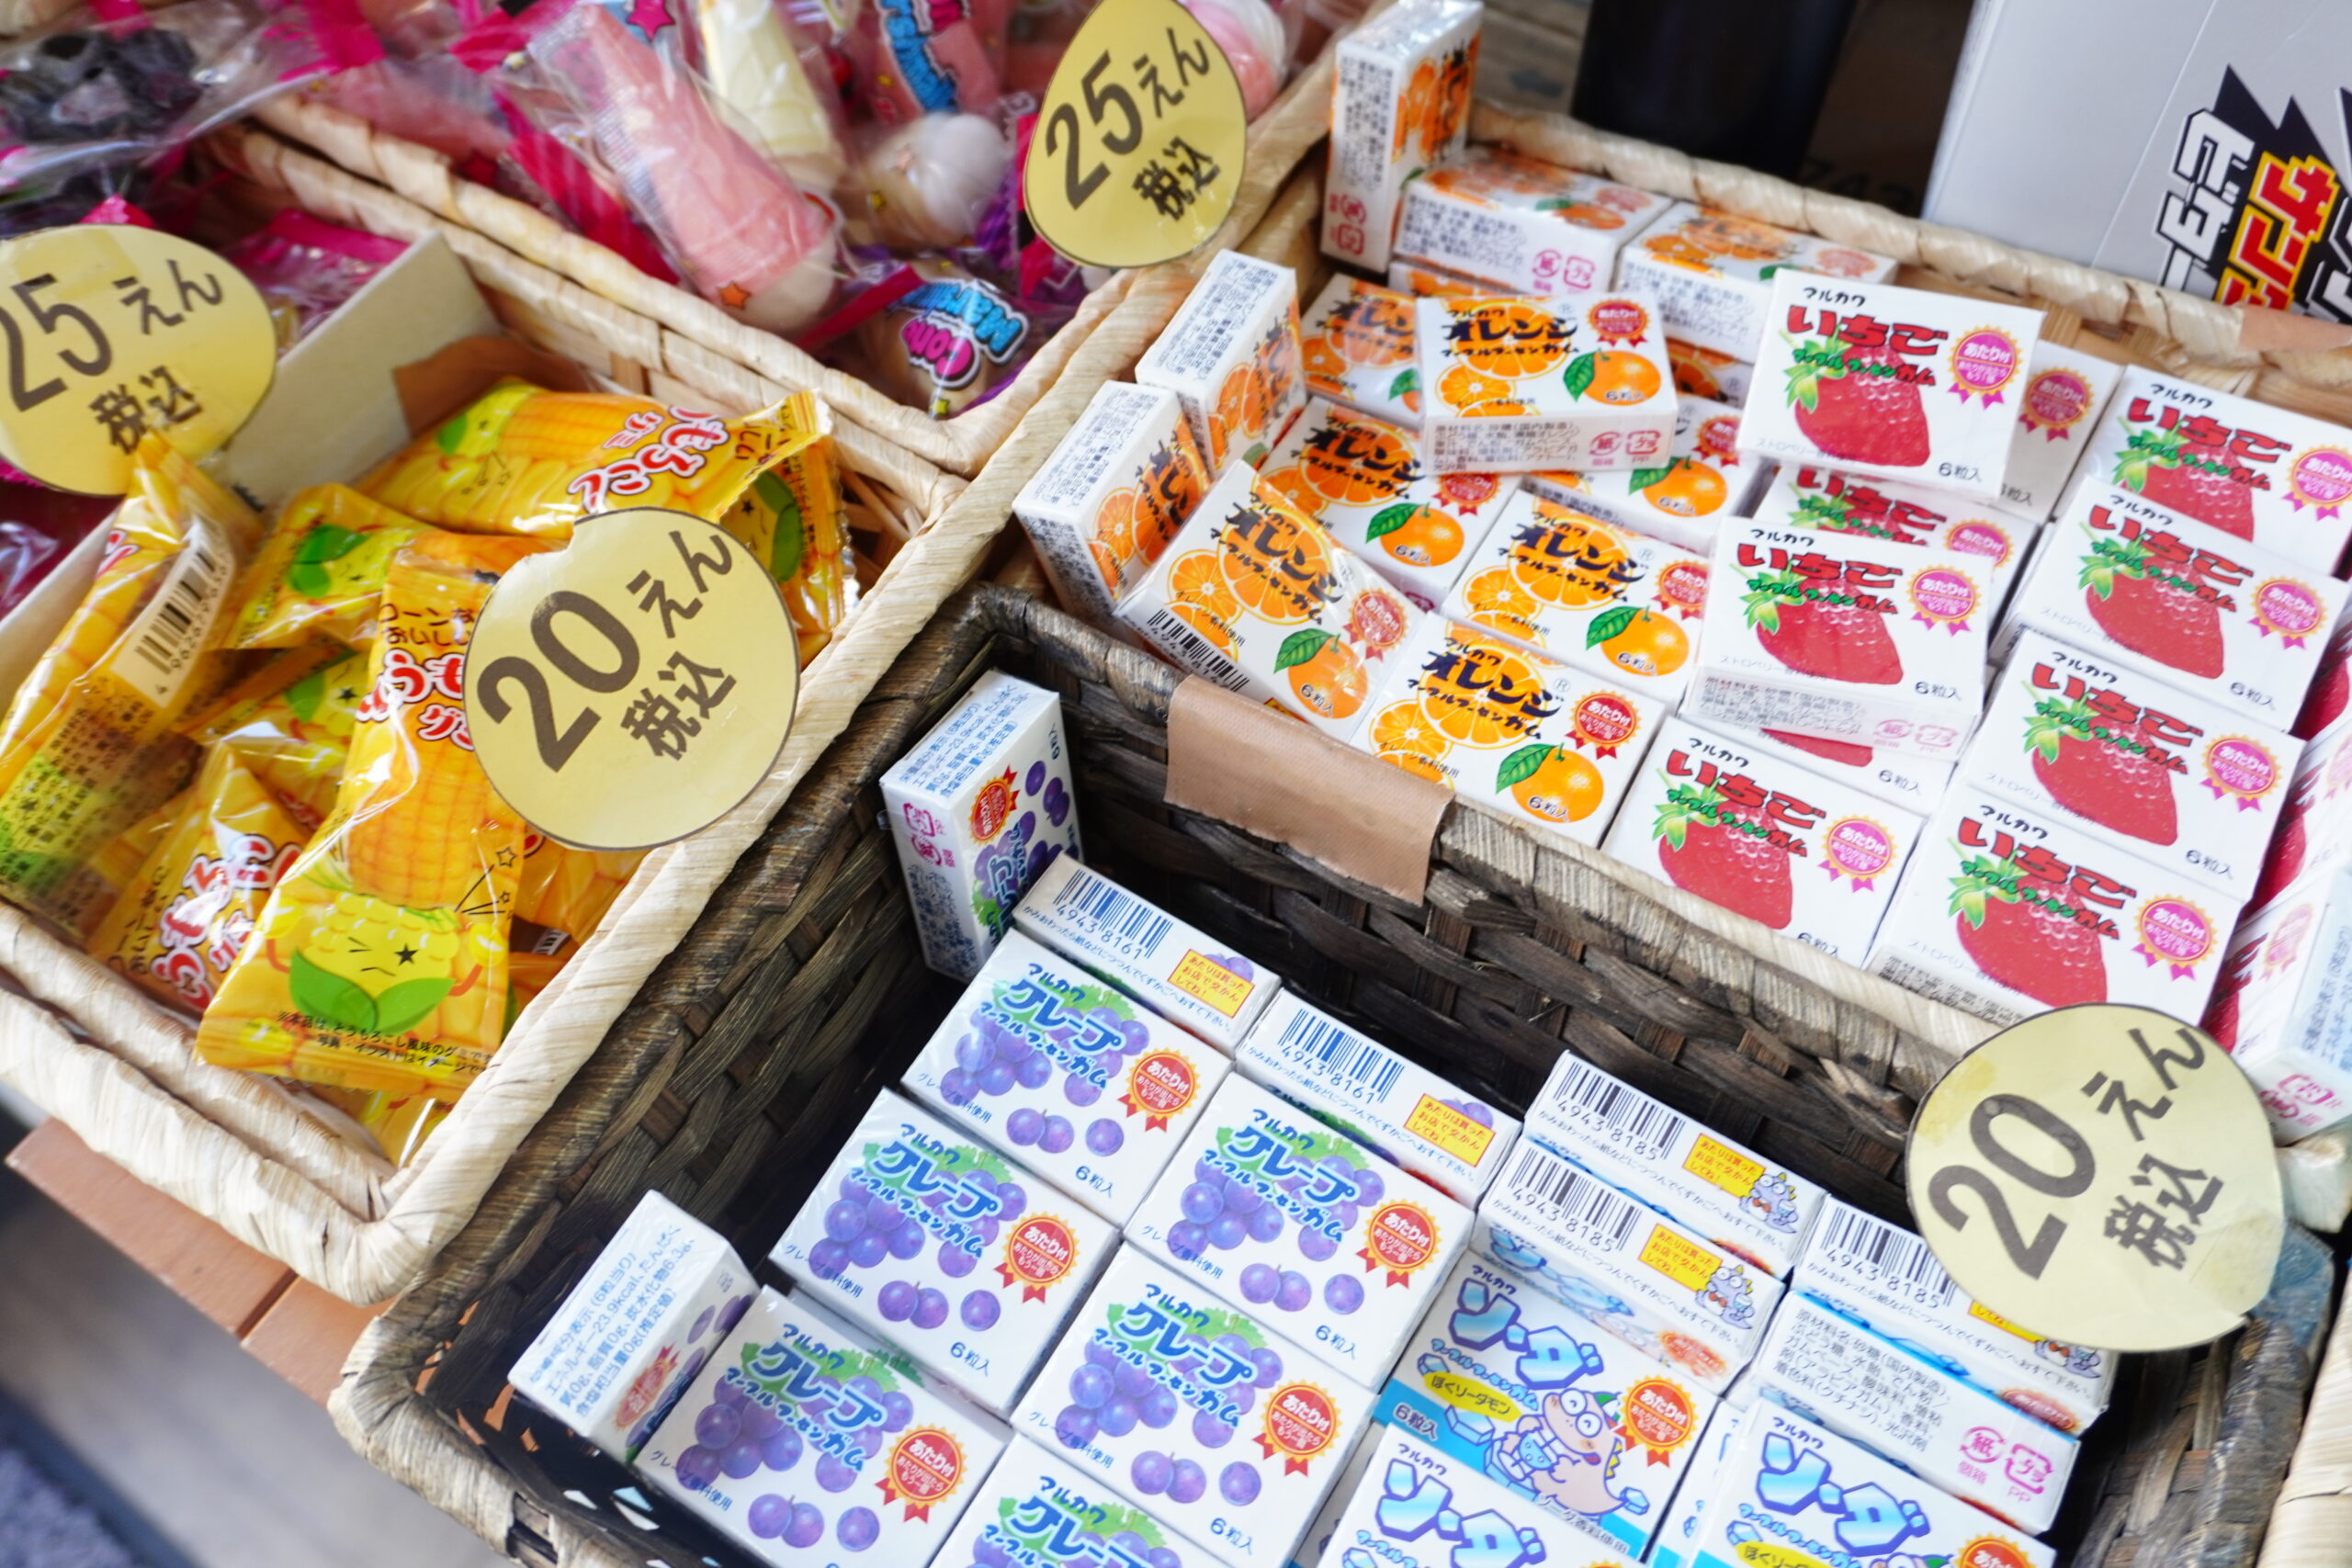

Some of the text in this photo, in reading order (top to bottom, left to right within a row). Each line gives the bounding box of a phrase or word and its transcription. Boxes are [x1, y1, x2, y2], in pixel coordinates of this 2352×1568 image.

[1046, 28, 1210, 210] 25えん
[1133, 137, 1219, 221] 税込
[1802, 285, 1864, 306] マルカワ
[1442, 321, 1577, 341] オレンジ
[1785, 304, 1948, 356] いちご
[90, 367, 202, 455] 税込
[2149, 382, 2212, 410] マルカワ
[2125, 396, 2290, 467] いちご
[1303, 429, 1430, 487] オレンジ
[1939, 463, 1984, 484] 6粒入
[1797, 466, 1947, 531] いちご
[2109, 493, 2172, 525] マルカワ
[1223, 502, 1345, 607] オレンジ
[1509, 520, 1645, 586] オレンジ
[1751, 528, 1814, 547] マルカワ
[2086, 505, 2253, 589] いちご
[1737, 543, 1901, 591] いちご
[477, 530, 733, 773] 20えん
[1617, 652, 1660, 677] 6粒入
[2051, 649, 2116, 682] マルカワ
[620, 651, 737, 761] 税込
[1299, 683, 1339, 721] 6粒入
[1419, 648, 1564, 721] オレンジ
[1915, 681, 1962, 700] 6粒入
[2030, 663, 2202, 750] いちご
[2228, 683, 2278, 714] 6粒入
[1686, 737, 1748, 769] マルカワ
[1664, 750, 1826, 833] いちご
[1879, 770, 1920, 795] 6粒入
[1527, 795, 1572, 822] 6粒入
[1978, 803, 2048, 840] マルカワ
[1954, 818, 2136, 912] いちご
[2183, 852, 2235, 884] 6粒入
[1057, 904, 1143, 960] 4943 8161
[1023, 962, 1084, 1004] マルカワ
[999, 976, 1124, 1066] グレープ
[1145, 1059, 1190, 1093] あたり付
[1282, 1046, 1375, 1104] 4943 8161
[896, 1121, 960, 1167] マルカワ
[1249, 1107, 1315, 1152] マルカワ
[1558, 1100, 1658, 1160] 4943 8185
[1225, 1122, 1358, 1219] グレープ
[1929, 1028, 2205, 1280] 20えん
[871, 1136, 1001, 1234] グレープ
[1075, 1164, 1118, 1198] 6粒入
[1383, 1211, 1431, 1247] あたり付
[1513, 1188, 1614, 1253] 4943 8185
[2105, 1155, 2223, 1271] 税込
[1023, 1224, 1069, 1261] あたり付
[1473, 1265, 1516, 1294] マルカワ
[1826, 1249, 1878, 1281] 4943
[1887, 1275, 1939, 1309] 8185
[1141, 1280, 1210, 1329] マルカワ
[778, 1322, 845, 1372] マルカワ
[948, 1339, 993, 1375] 6粒入
[1116, 1297, 1255, 1401] グレープ
[1314, 1323, 1361, 1360] 6粒入
[1449, 1279, 1604, 1390] ソーダ
[750, 1338, 886, 1445] グレープ
[1280, 1393, 1329, 1431] あたり付
[1640, 1389, 1687, 1423] あたり付
[1394, 1404, 1439, 1441] 6粒入
[1772, 1416, 1825, 1450] マルカワ
[908, 1438, 956, 1478] あたり付
[1398, 1443, 1447, 1475] マルカワ
[1040, 1475, 1107, 1525] マルカワ
[1376, 1458, 1547, 1568] ソーダ
[1757, 1432, 1930, 1556] ソーダ
[2007, 1487, 2030, 1502] PP
[1209, 1516, 1258, 1555] 6粒入
